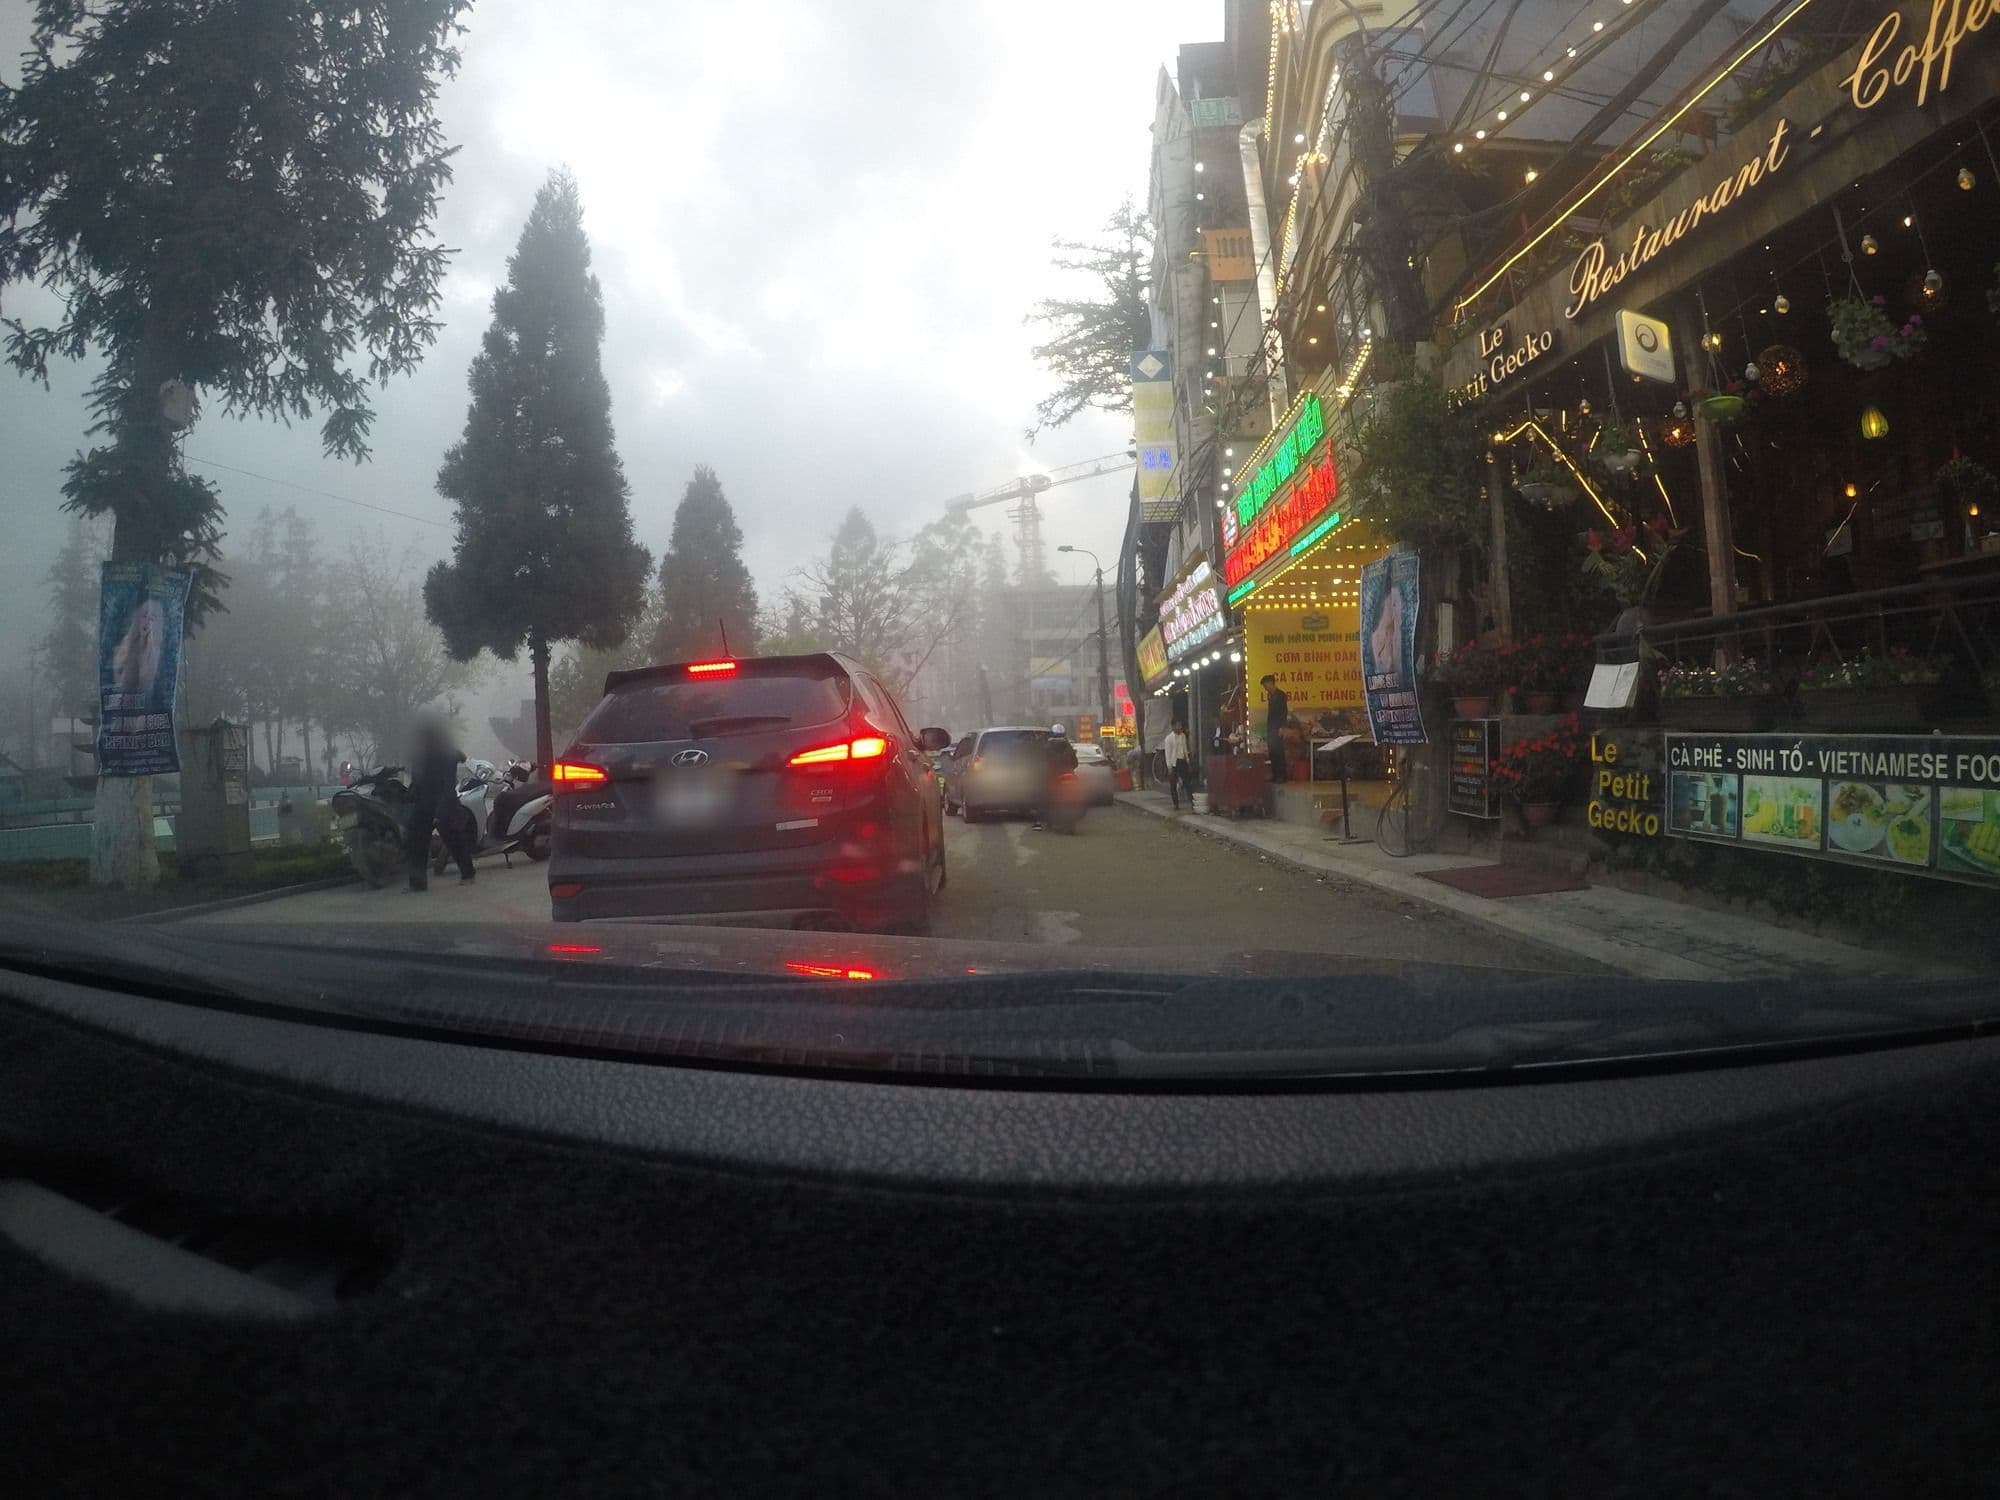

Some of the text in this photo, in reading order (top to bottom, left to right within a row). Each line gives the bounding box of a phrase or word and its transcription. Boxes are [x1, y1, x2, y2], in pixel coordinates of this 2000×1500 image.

[1565, 118, 1791, 320] Restaurant
[1838, 0, 2000, 109] Coffe
[1480, 328, 1504, 358] Le
[1490, 330, 1552, 384] Gecko
[1591, 736, 1617, 763] Le
[1671, 742, 1690, 766] CÀ
[1694, 743, 1723, 768] PHÊ
[1736, 748, 1774, 771] SINH
[1779, 741, 1804, 772] TỐ
[1819, 750, 1949, 780] VIETNAMESE
[1599, 769, 1649, 800] Petit
[1588, 800, 1659, 836] Gecko
